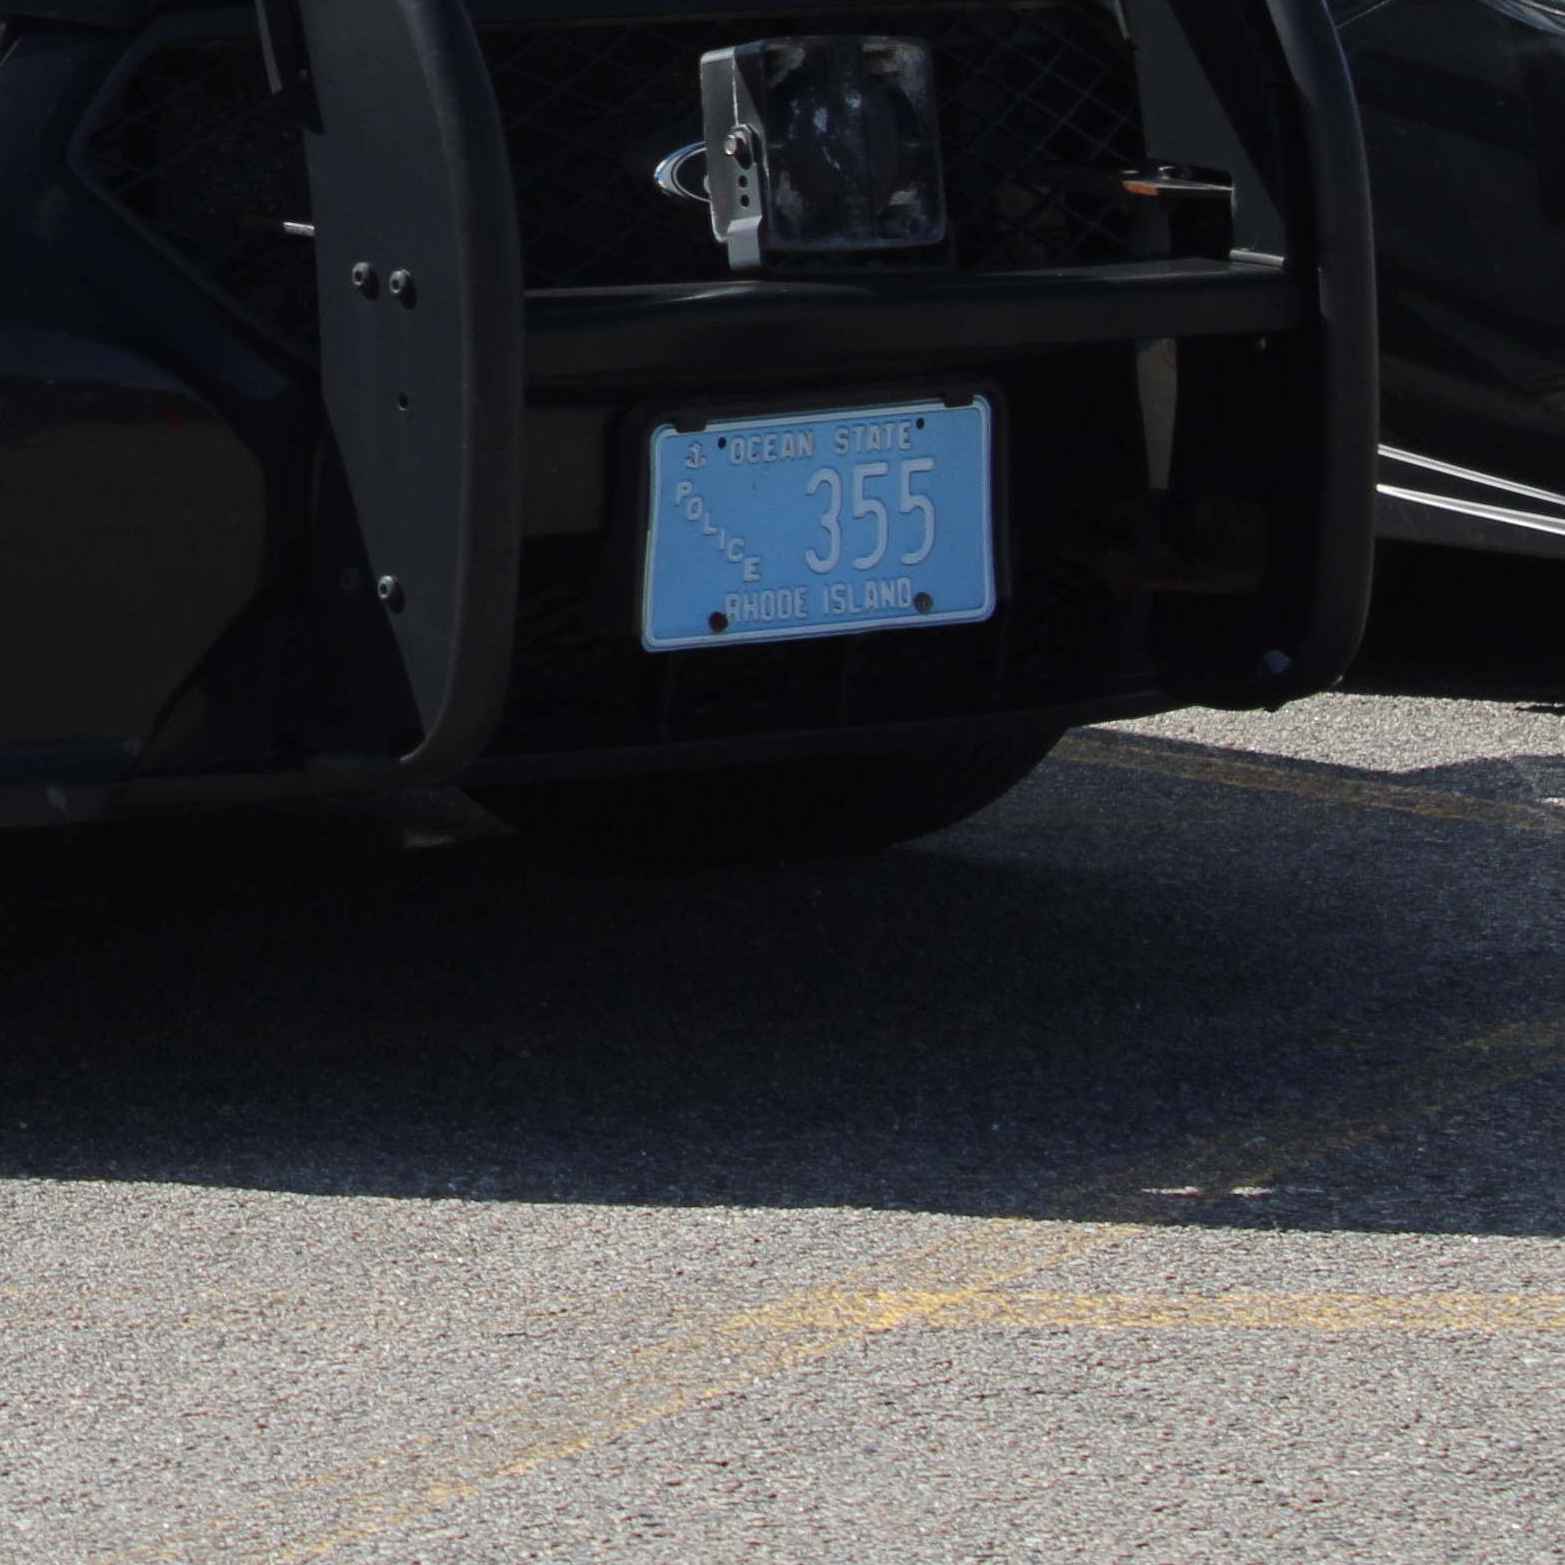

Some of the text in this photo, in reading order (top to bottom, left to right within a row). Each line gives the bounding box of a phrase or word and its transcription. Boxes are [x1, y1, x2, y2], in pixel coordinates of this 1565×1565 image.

[728, 420, 913, 466] OCEAN STATE
[674, 480, 762, 583] POLICE
[804, 456, 937, 574] 355
[724, 576, 913, 624] RHODE ISLAND
